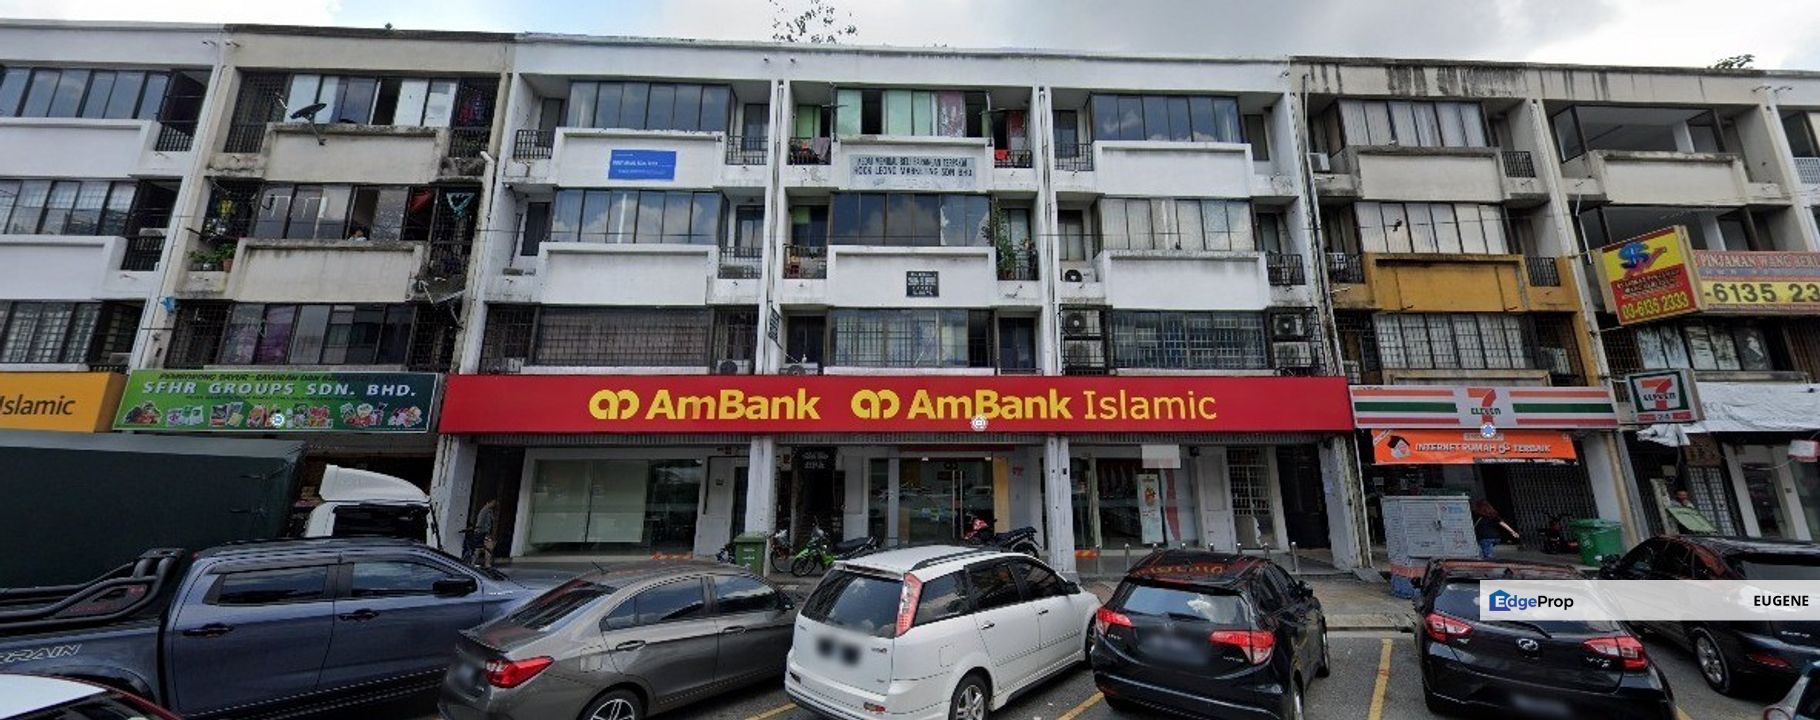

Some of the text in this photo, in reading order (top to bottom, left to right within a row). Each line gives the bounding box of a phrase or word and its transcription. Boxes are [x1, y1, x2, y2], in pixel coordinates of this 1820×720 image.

[1700, 254, 1756, 268] PINJAMAN
[1622, 297, 1660, 319] 03-6135
[1661, 291, 1689, 312] 2333
[142, 381, 417, 397] SFHR GROUPS SDN. BHD.
[645, 388, 1217, 421] AmBank AmBank Islamic
[0, 643, 82, 663] RAIN
